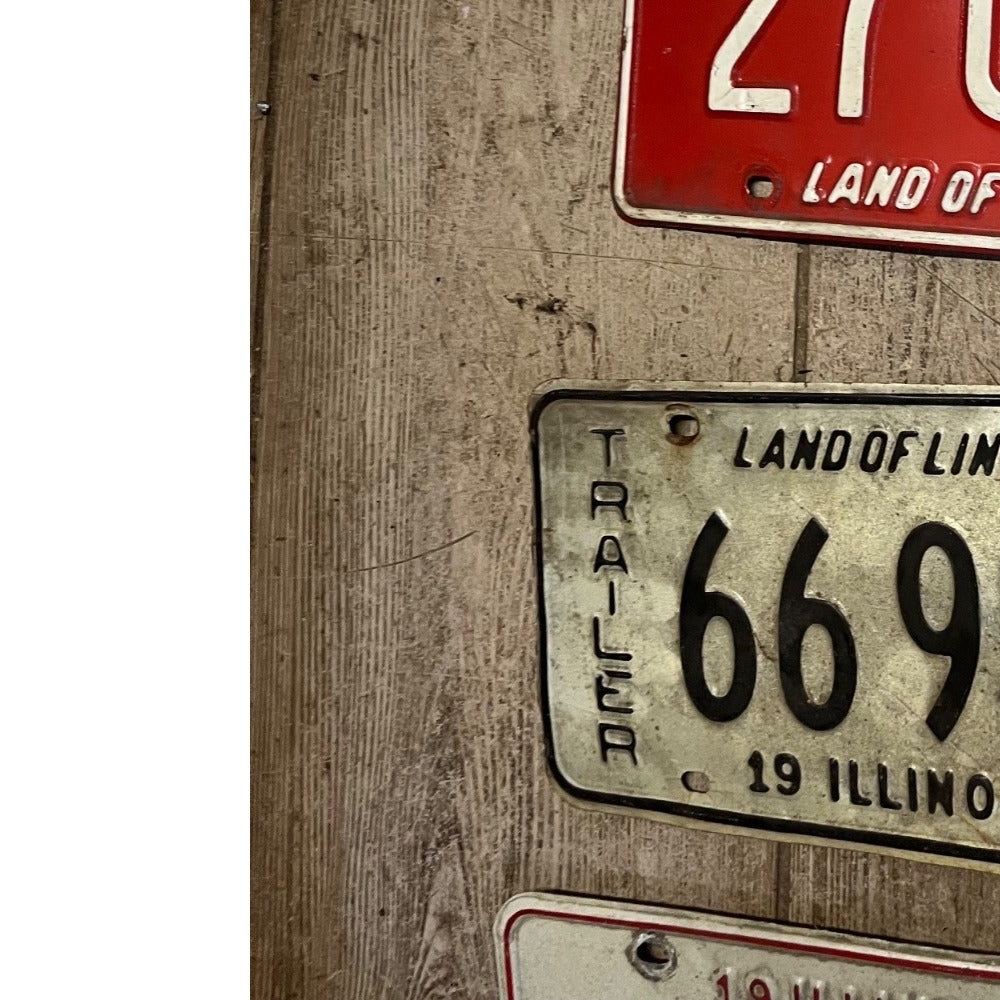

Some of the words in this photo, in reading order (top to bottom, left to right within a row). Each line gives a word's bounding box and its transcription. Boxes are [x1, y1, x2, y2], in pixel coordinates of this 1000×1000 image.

[803, 160, 931, 212] LAND
[734, 426, 849, 473] LAND
[858, 429, 922, 475] OF
[589, 427, 637, 767] TRAILER
[746, 751, 801, 797] 19
